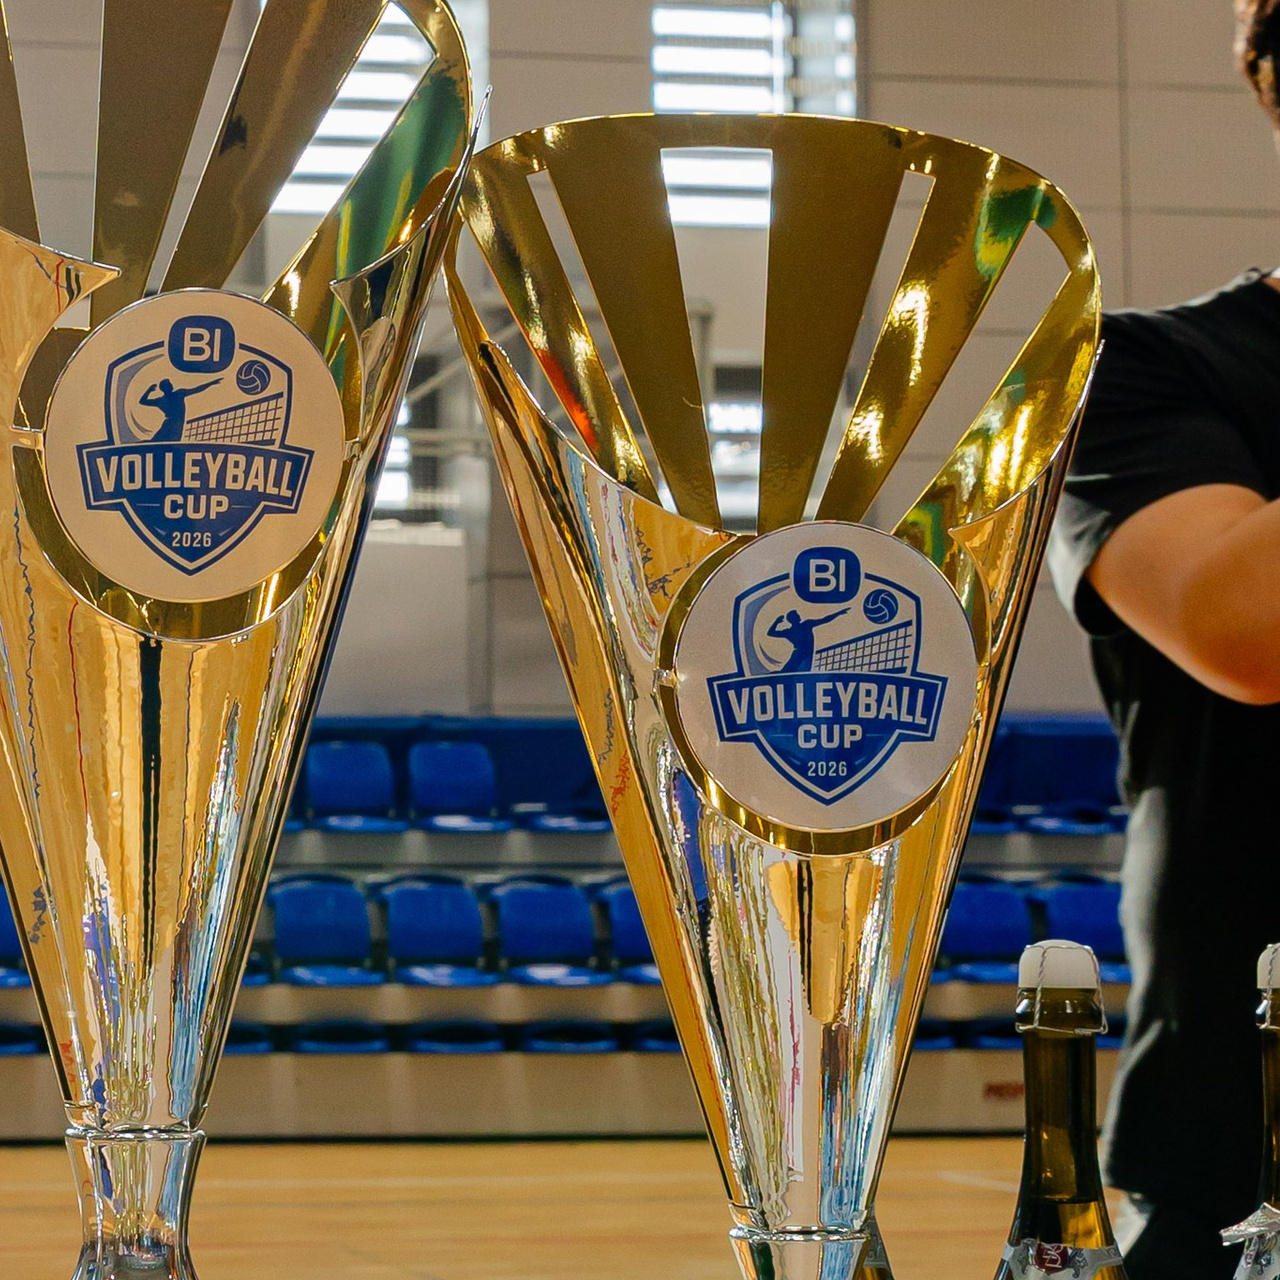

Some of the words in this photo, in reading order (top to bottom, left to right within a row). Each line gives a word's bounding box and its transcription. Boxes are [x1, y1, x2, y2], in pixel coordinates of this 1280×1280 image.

[183, 327, 221, 362] BI
[96, 452, 293, 498] VOLLEYBALL
[163, 494, 229, 519] CUP
[172, 532, 212, 547] 2026
[808, 558, 846, 592] BI
[727, 682, 928, 725] VOLLEYBALL
[797, 724, 863, 749] CUP
[807, 761, 848, 777] 2026
